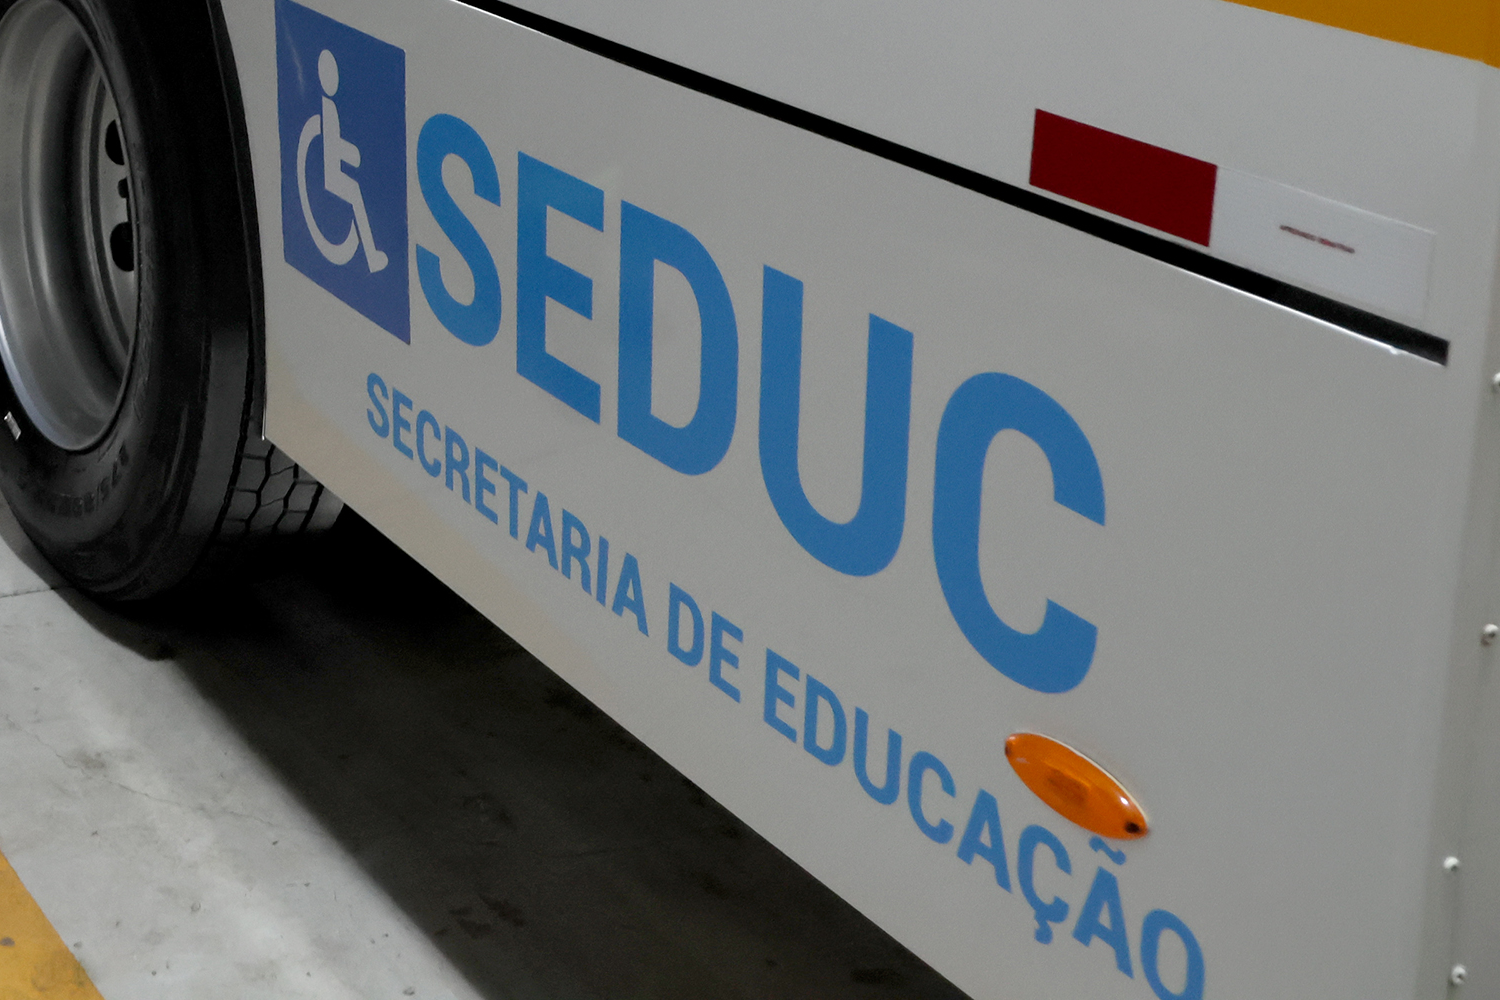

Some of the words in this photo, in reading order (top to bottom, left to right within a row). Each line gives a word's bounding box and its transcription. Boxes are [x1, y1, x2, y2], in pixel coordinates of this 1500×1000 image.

[366, 372, 649, 636] SECRETARIA
[667, 582, 744, 703] DE
[763, 648, 1206, 1000] EDUCAÇÃO
[415, 113, 1106, 694] SEDUC
